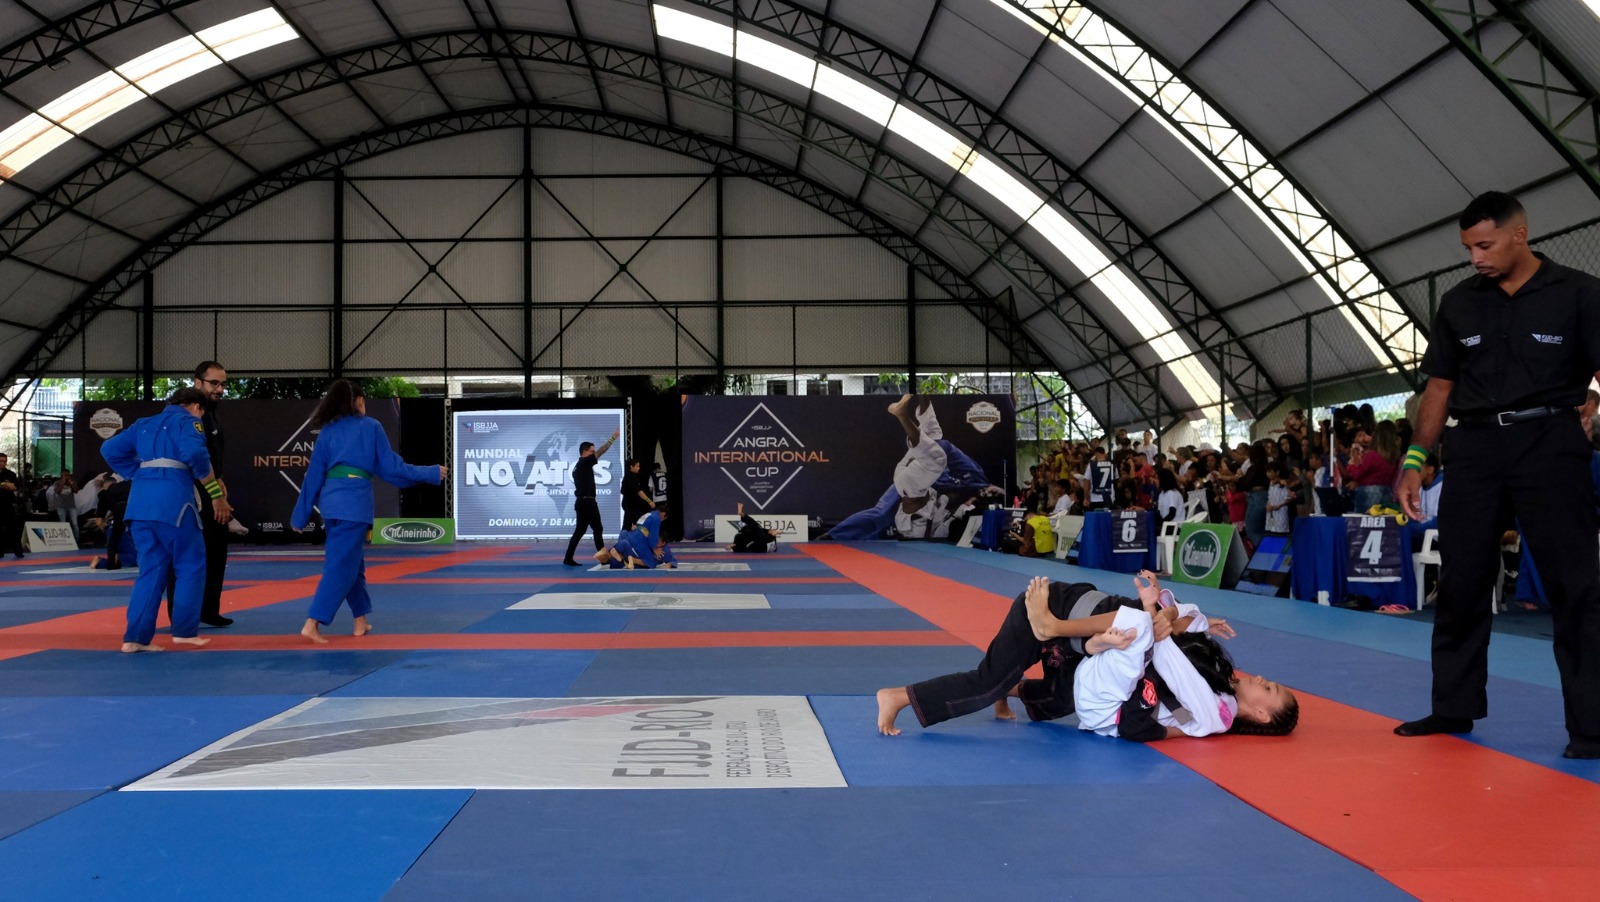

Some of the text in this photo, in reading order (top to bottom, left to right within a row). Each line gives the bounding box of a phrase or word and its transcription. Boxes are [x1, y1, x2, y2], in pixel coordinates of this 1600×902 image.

[473, 422, 499, 430] ISBJJA
[733, 436, 790, 448] ANGRA
[464, 449, 523, 459] MUNDIAL
[694, 451, 830, 463] INTERNATIONAL
[465, 456, 612, 487] NOVATS
[745, 466, 779, 478] CUP
[1099, 467, 1111, 488] 7
[658, 476, 667, 491] 6
[488, 518, 540, 528] DOMINGO,
[542, 518, 549, 528] 7
[550, 518, 562, 527] DE
[388, 526, 437, 539] Mineirinho
[1121, 519, 1137, 543] 6
[1360, 530, 1383, 565] 4
[611, 709, 715, 778] FJJD-RIO
